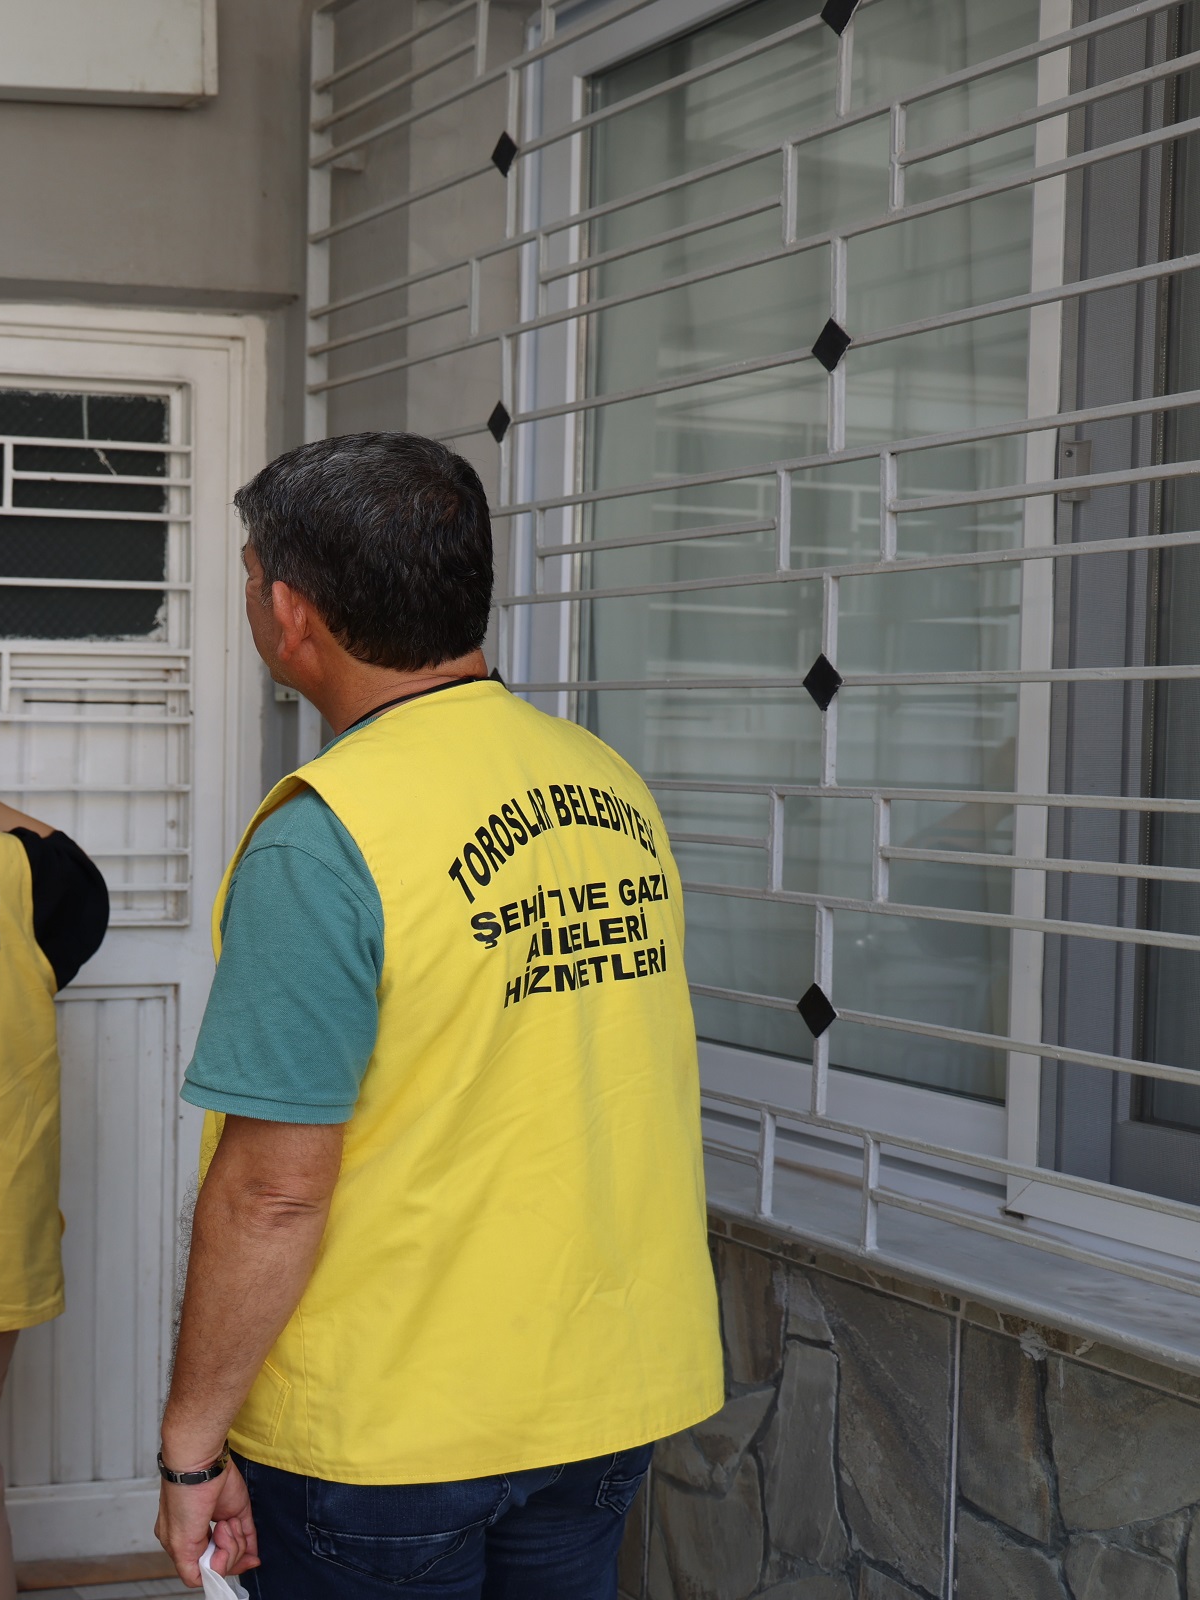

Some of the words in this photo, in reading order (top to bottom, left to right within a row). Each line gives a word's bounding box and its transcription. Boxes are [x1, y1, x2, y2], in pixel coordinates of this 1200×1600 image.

[448, 787, 554, 904] TOROSLAR
[470, 885, 567, 949] ŞEHİT
[568, 881, 610, 913] VE
[618, 868, 669, 907] GAZİ
[526, 906, 649, 964] AİLELERİ
[503, 938, 668, 1009] HİZMETLERİ
